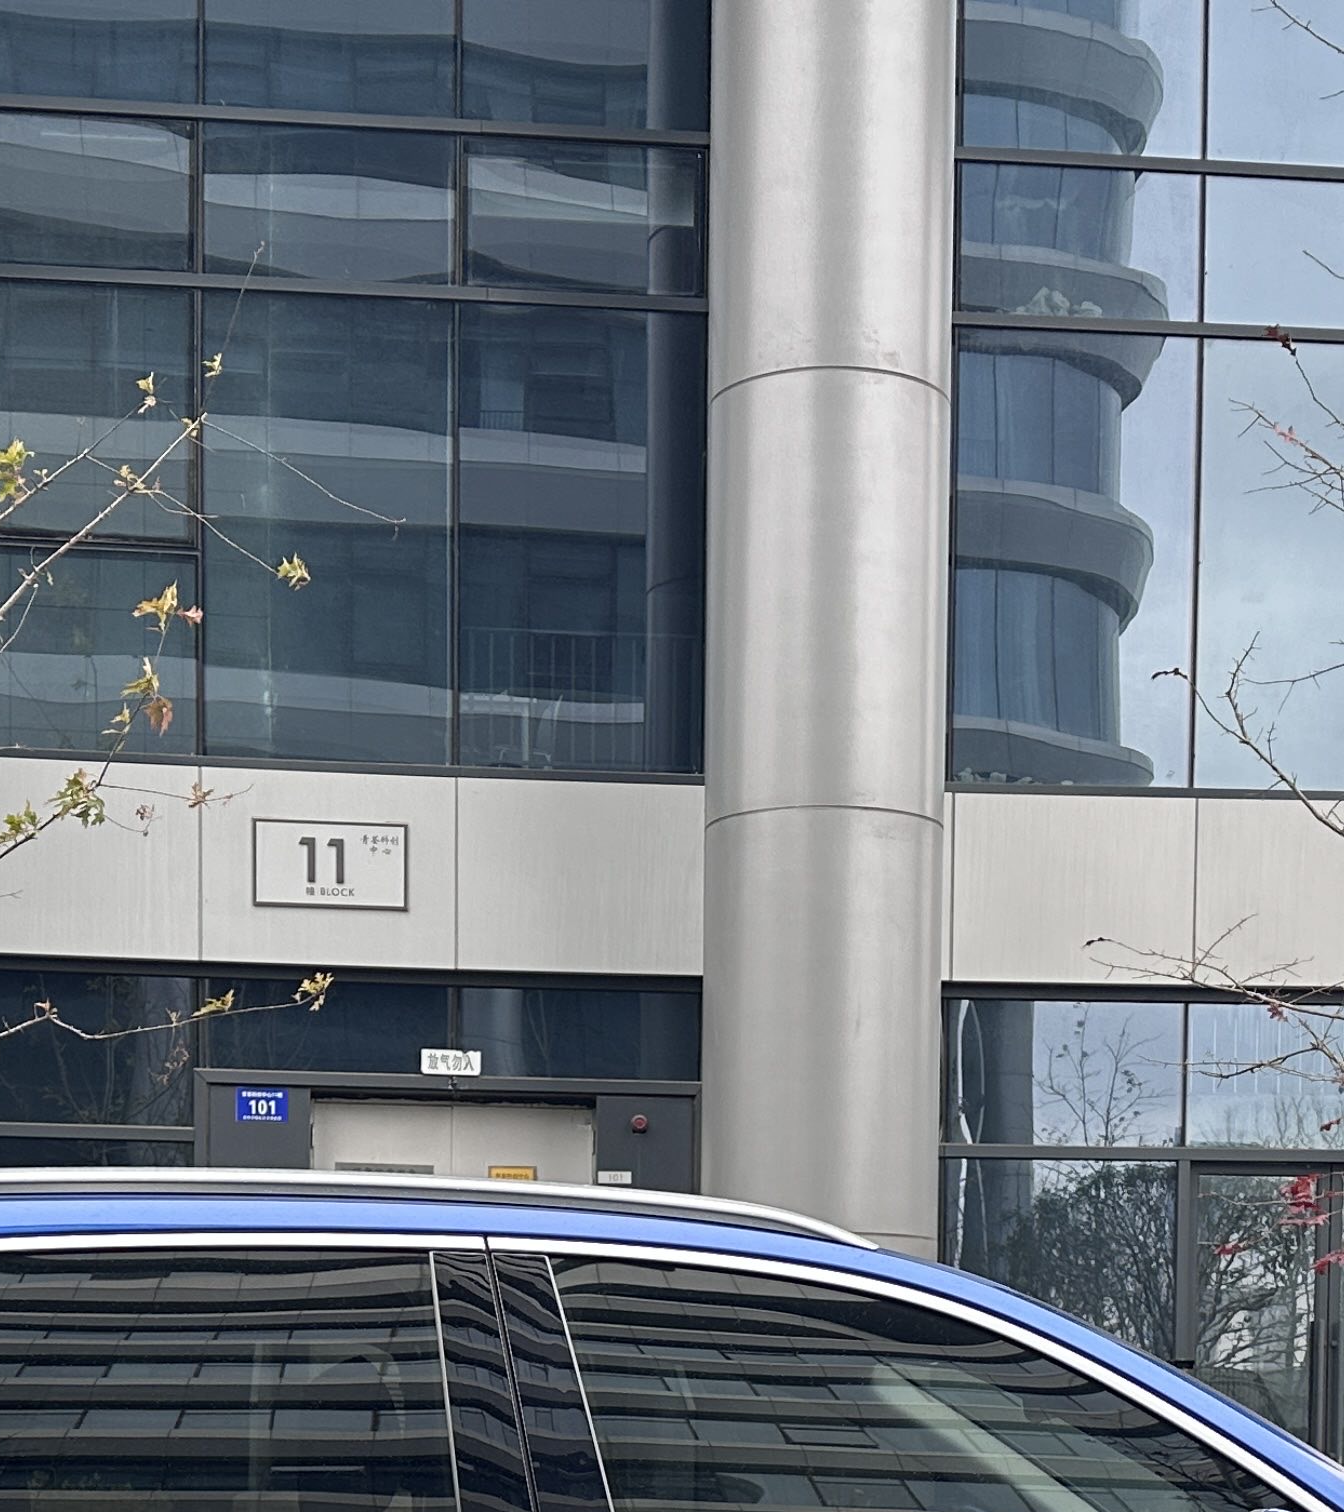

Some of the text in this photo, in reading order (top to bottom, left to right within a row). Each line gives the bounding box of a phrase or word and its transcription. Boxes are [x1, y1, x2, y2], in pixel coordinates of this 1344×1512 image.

[298, 836, 345, 884] 11
[320, 886, 355, 897] BLOCK
[248, 1099, 276, 1115] 101
